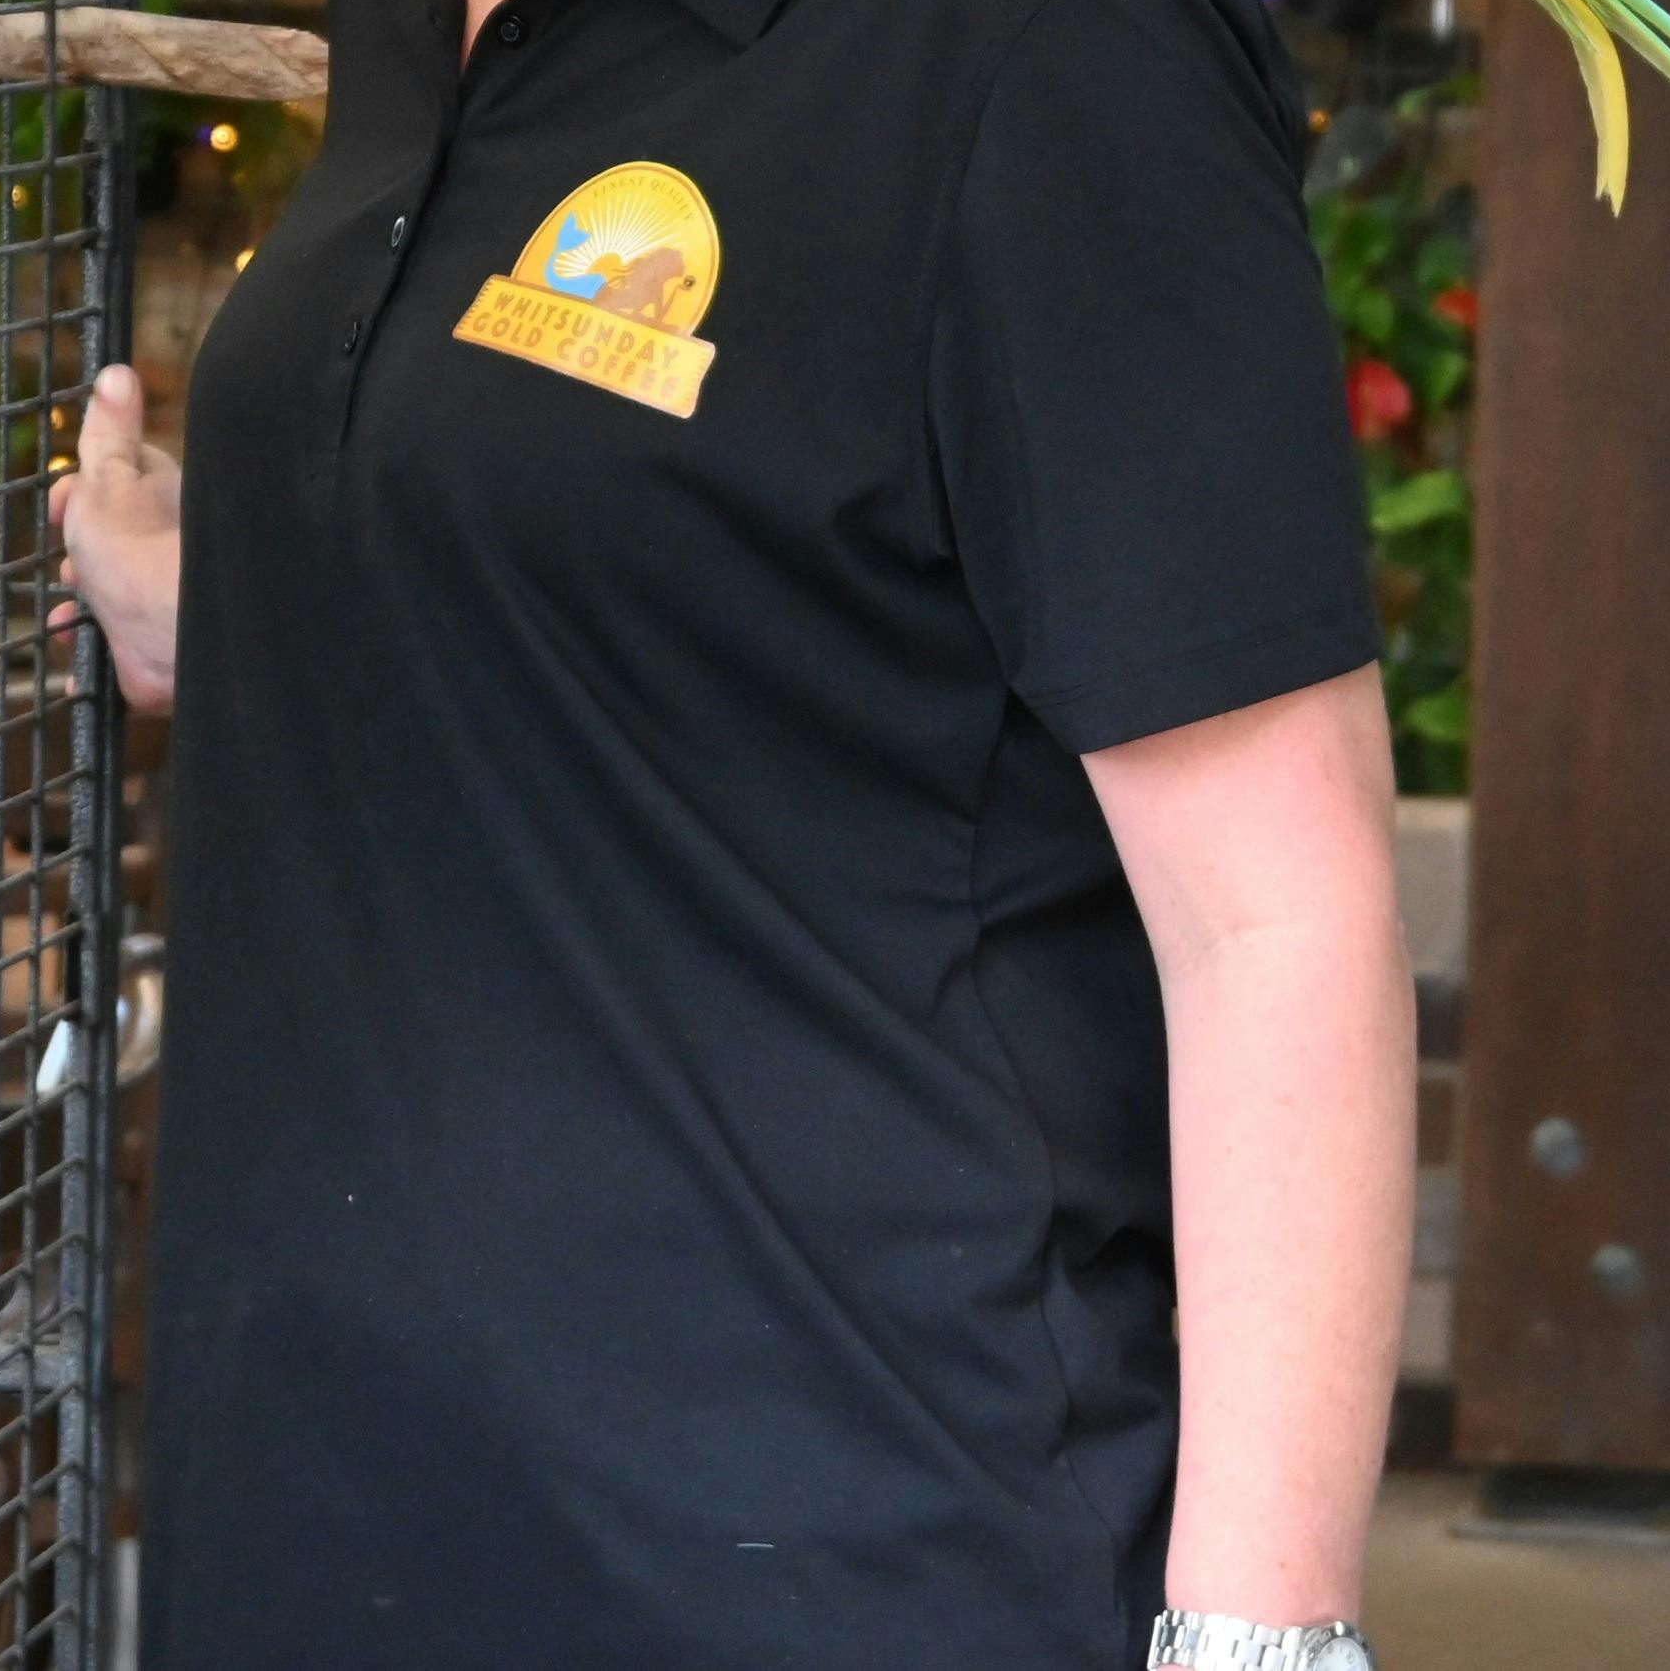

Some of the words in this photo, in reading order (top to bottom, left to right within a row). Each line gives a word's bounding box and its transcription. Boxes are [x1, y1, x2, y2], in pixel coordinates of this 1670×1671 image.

[472, 311, 543, 348] GOLD
[556, 336, 680, 399] COFFEE
[493, 291, 680, 369] WHITSUNDAY
